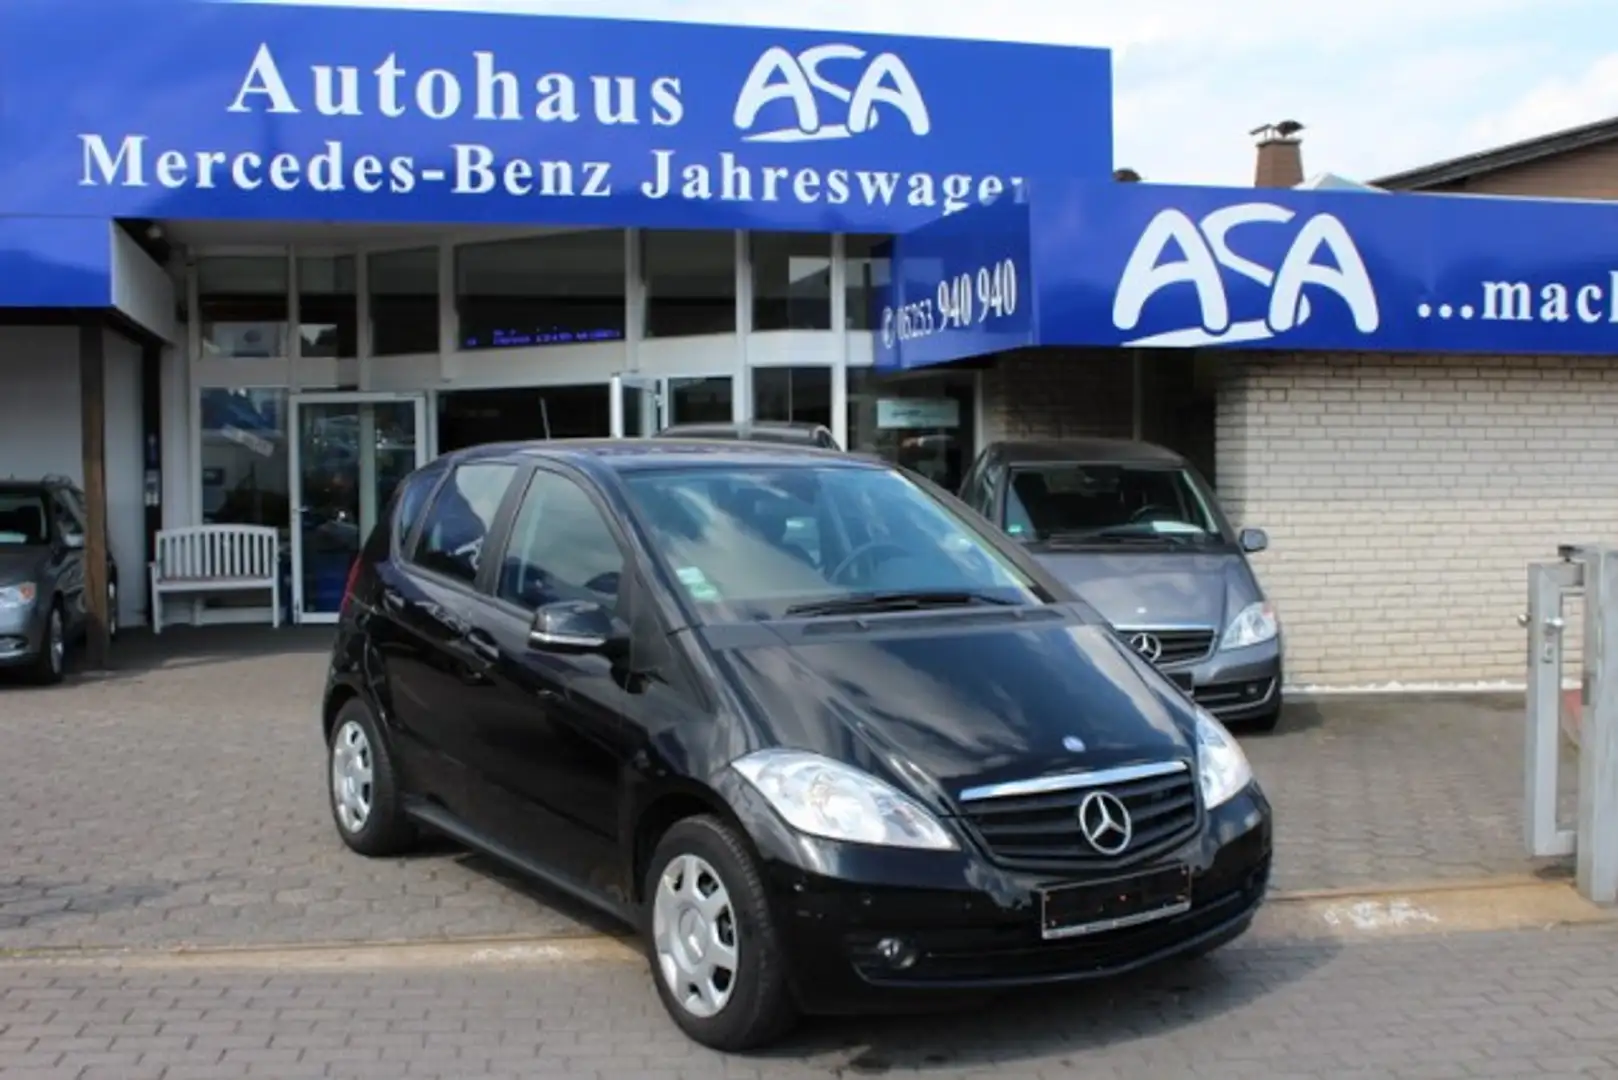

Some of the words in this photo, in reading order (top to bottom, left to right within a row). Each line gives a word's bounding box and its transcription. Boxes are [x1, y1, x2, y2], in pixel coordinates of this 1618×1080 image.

[228, 42, 683, 127] Autohaus
[734, 44, 930, 143] ASA
[79, 133, 611, 197] Mercedes-Benz
[937, 273, 972, 332] 940
[977, 258, 1017, 323] 940
[1112, 202, 1380, 347] ASA
